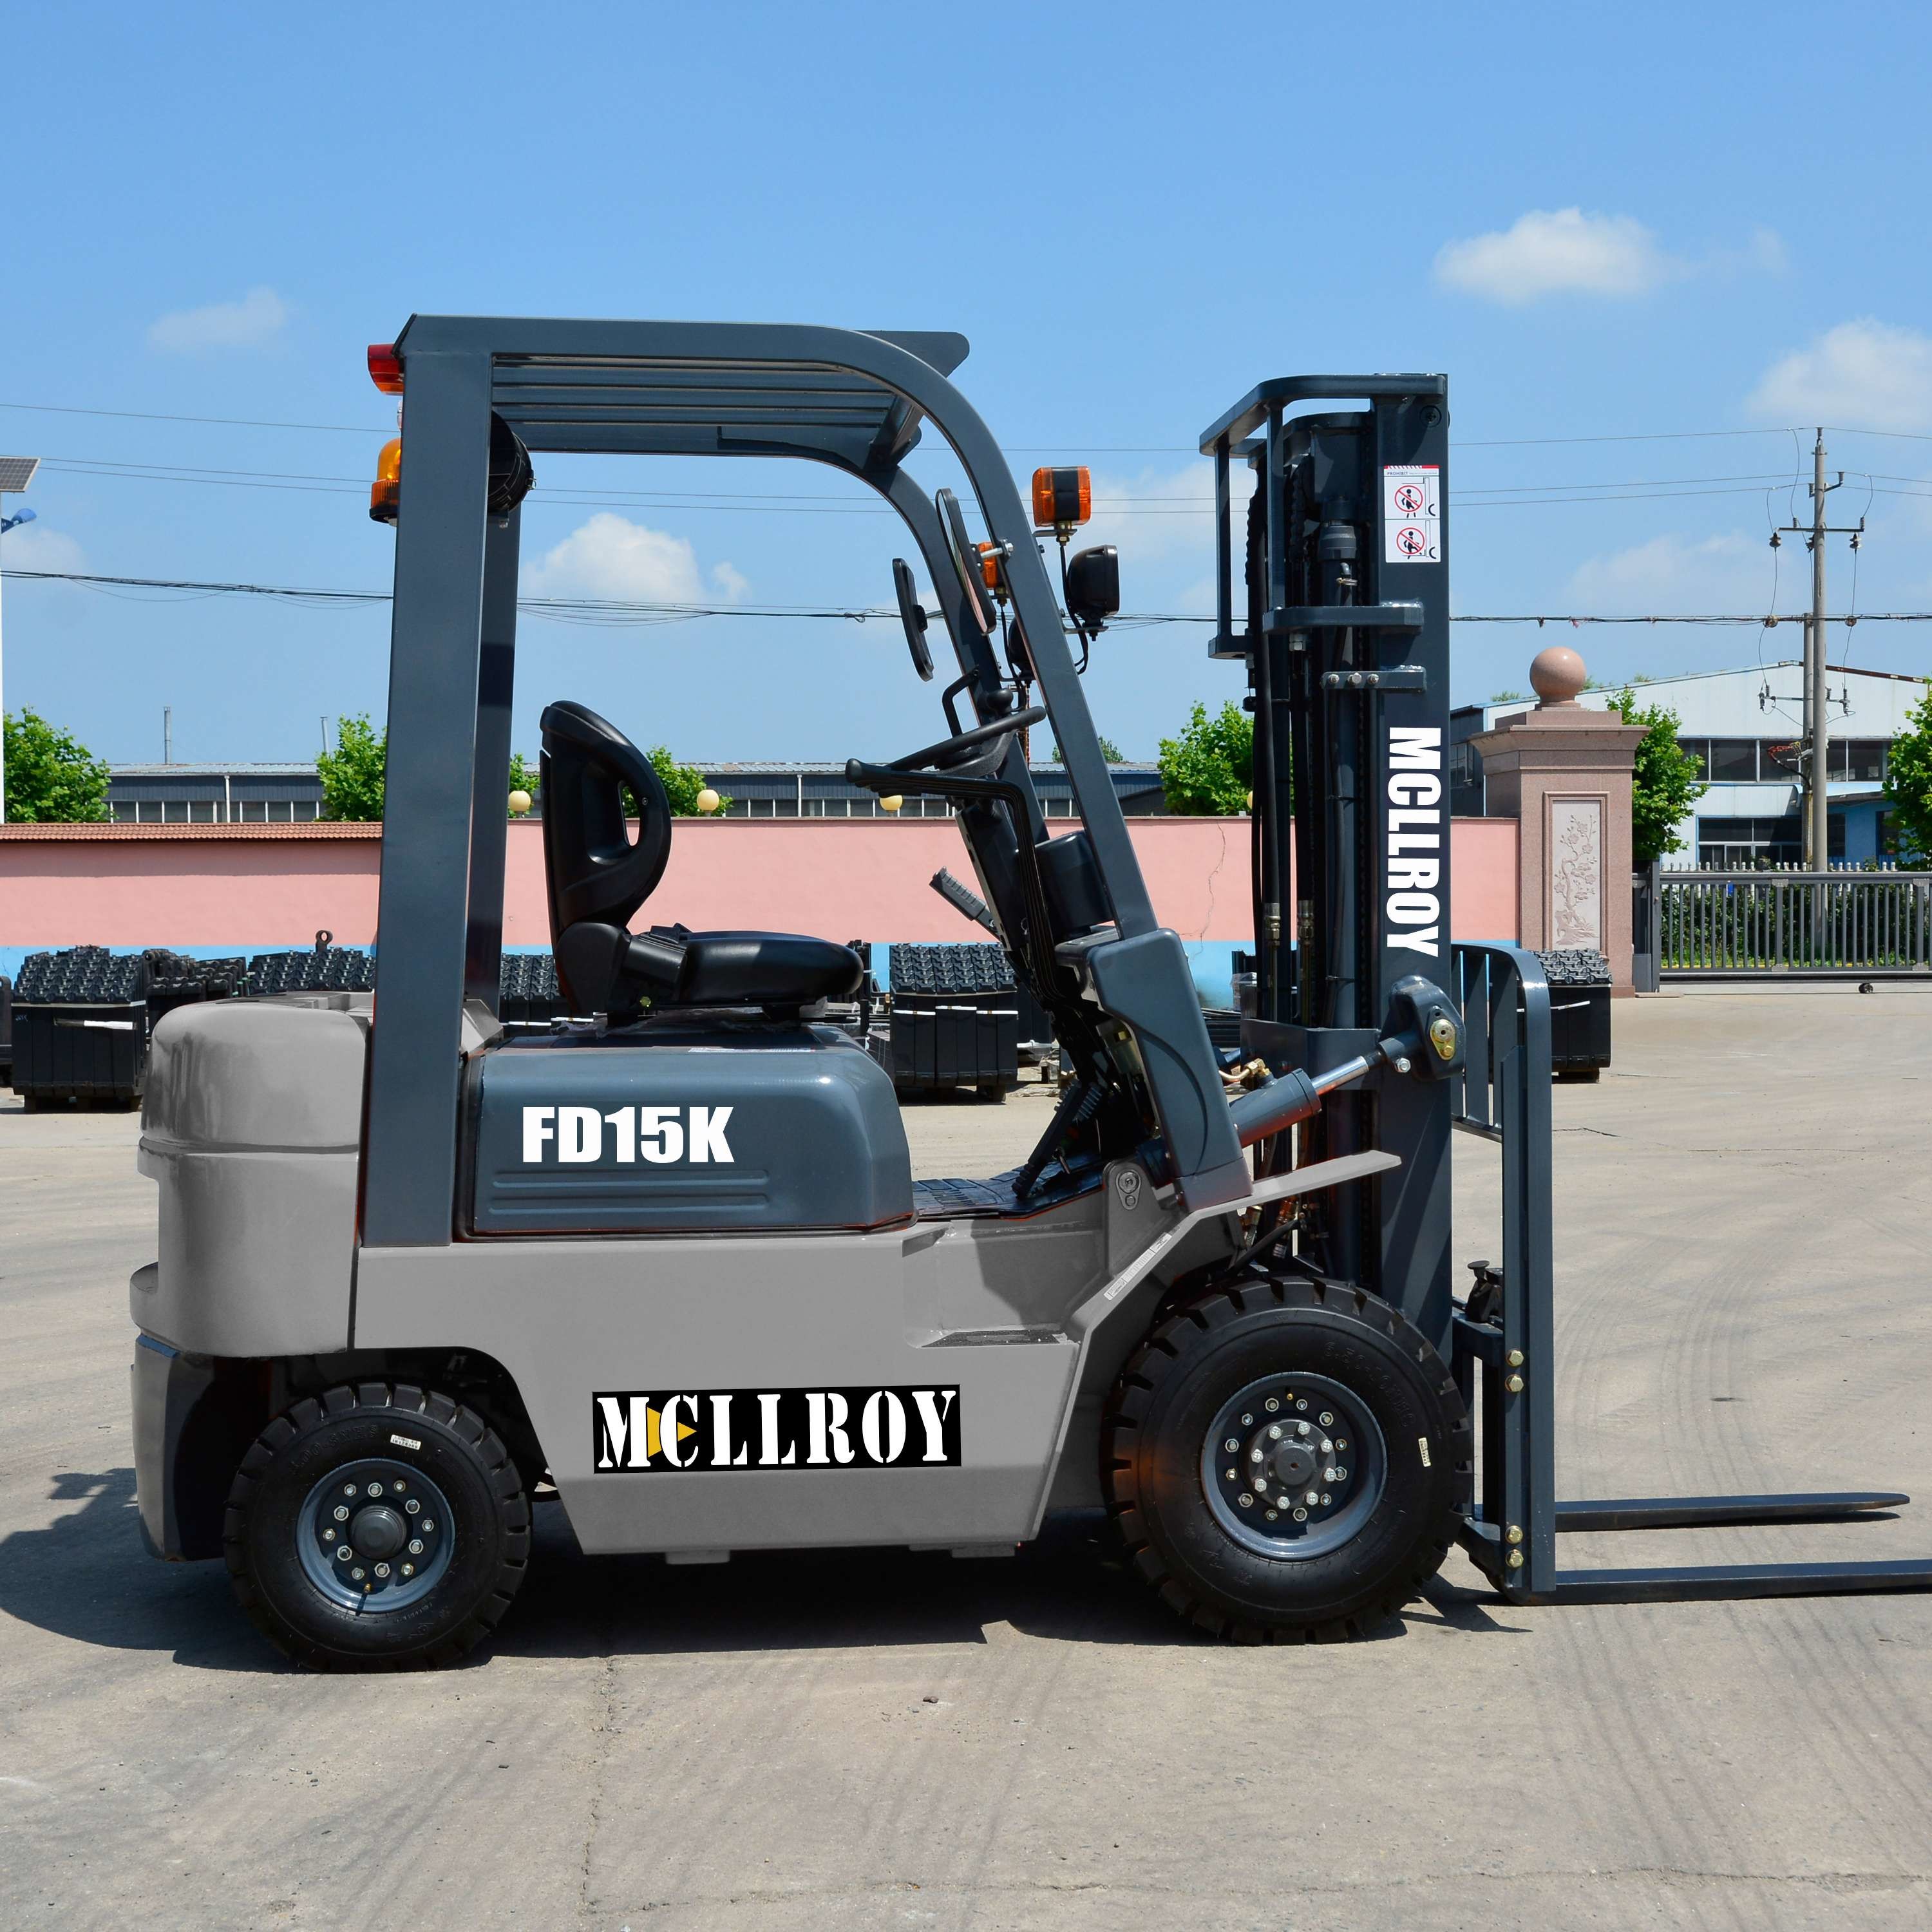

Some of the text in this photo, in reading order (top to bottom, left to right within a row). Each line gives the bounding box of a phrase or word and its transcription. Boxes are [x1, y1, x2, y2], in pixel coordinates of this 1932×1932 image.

[1386, 727, 1441, 958] MCLLROY
[522, 1106, 735, 1164] FD15K
[596, 1390, 956, 1468] MCLLROY
